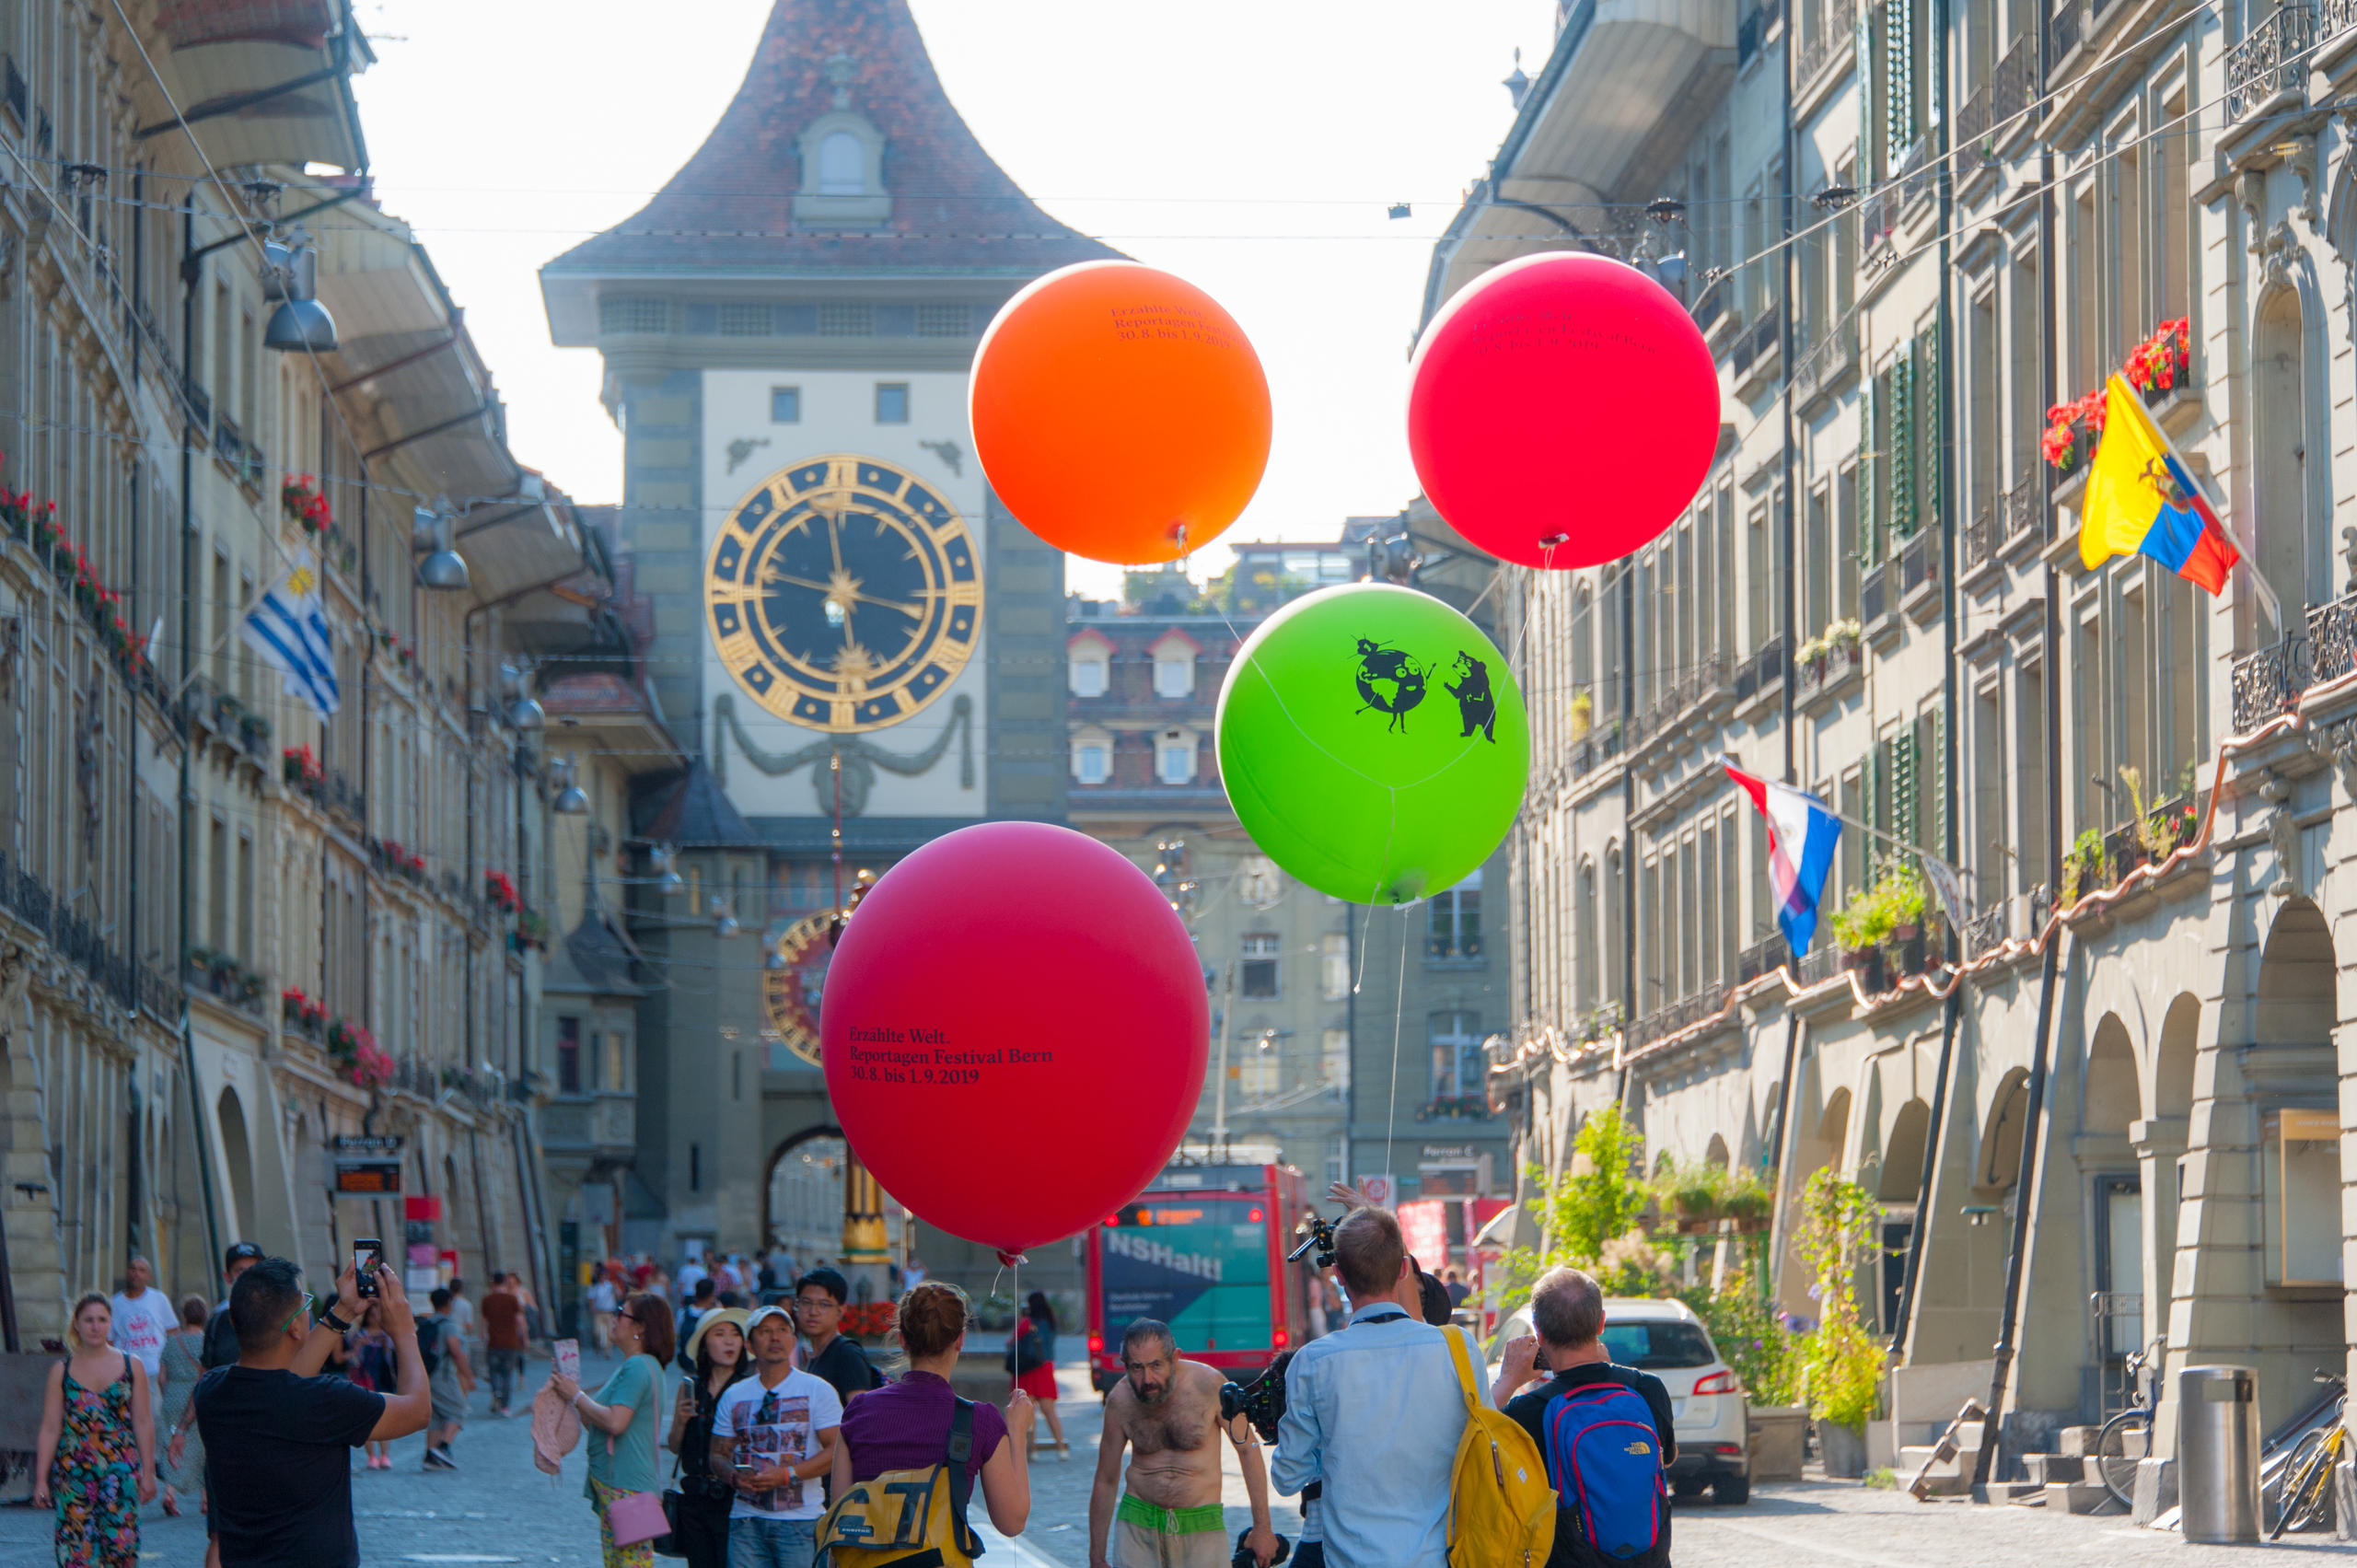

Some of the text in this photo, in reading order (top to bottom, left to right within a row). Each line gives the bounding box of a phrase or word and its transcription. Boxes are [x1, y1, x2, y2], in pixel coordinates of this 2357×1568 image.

[1158, 328, 1178, 340] bis
[849, 1026, 951, 1044] Erzählte Welt.
[850, 1046, 1053, 1066] Reportagen Festival Bern
[851, 1064, 882, 1081] 30.8.
[885, 1067, 906, 1083] bis
